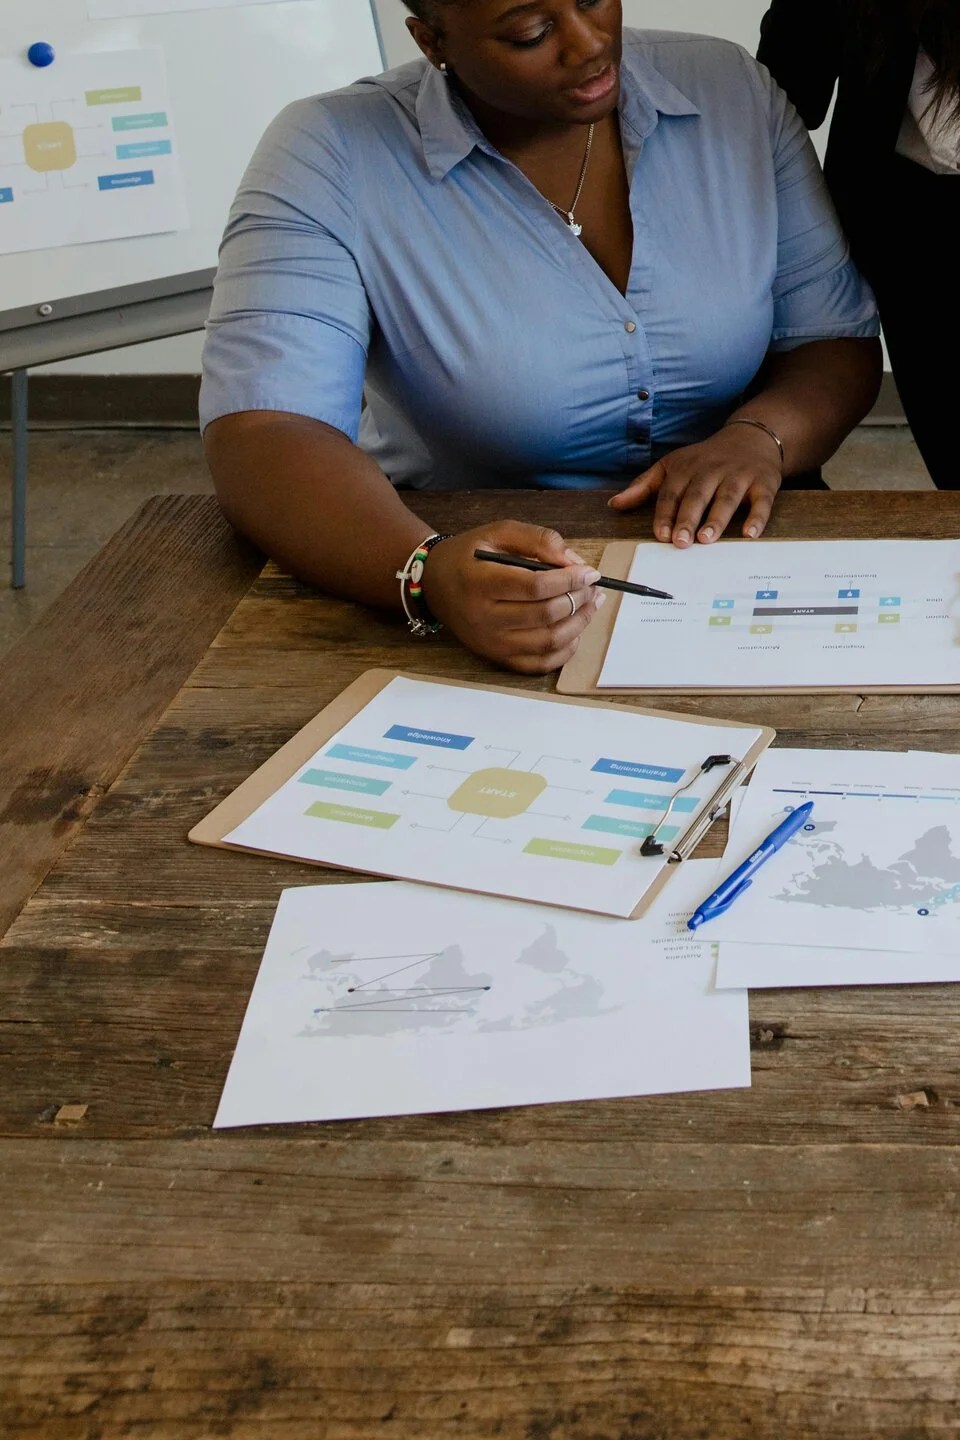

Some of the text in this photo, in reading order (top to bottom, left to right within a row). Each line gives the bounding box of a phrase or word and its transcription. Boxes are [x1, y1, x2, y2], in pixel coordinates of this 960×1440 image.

[407, 731, 451, 743] Knowledge
[610, 763, 667, 776] Brainstorming
[477, 787, 518, 799] START
